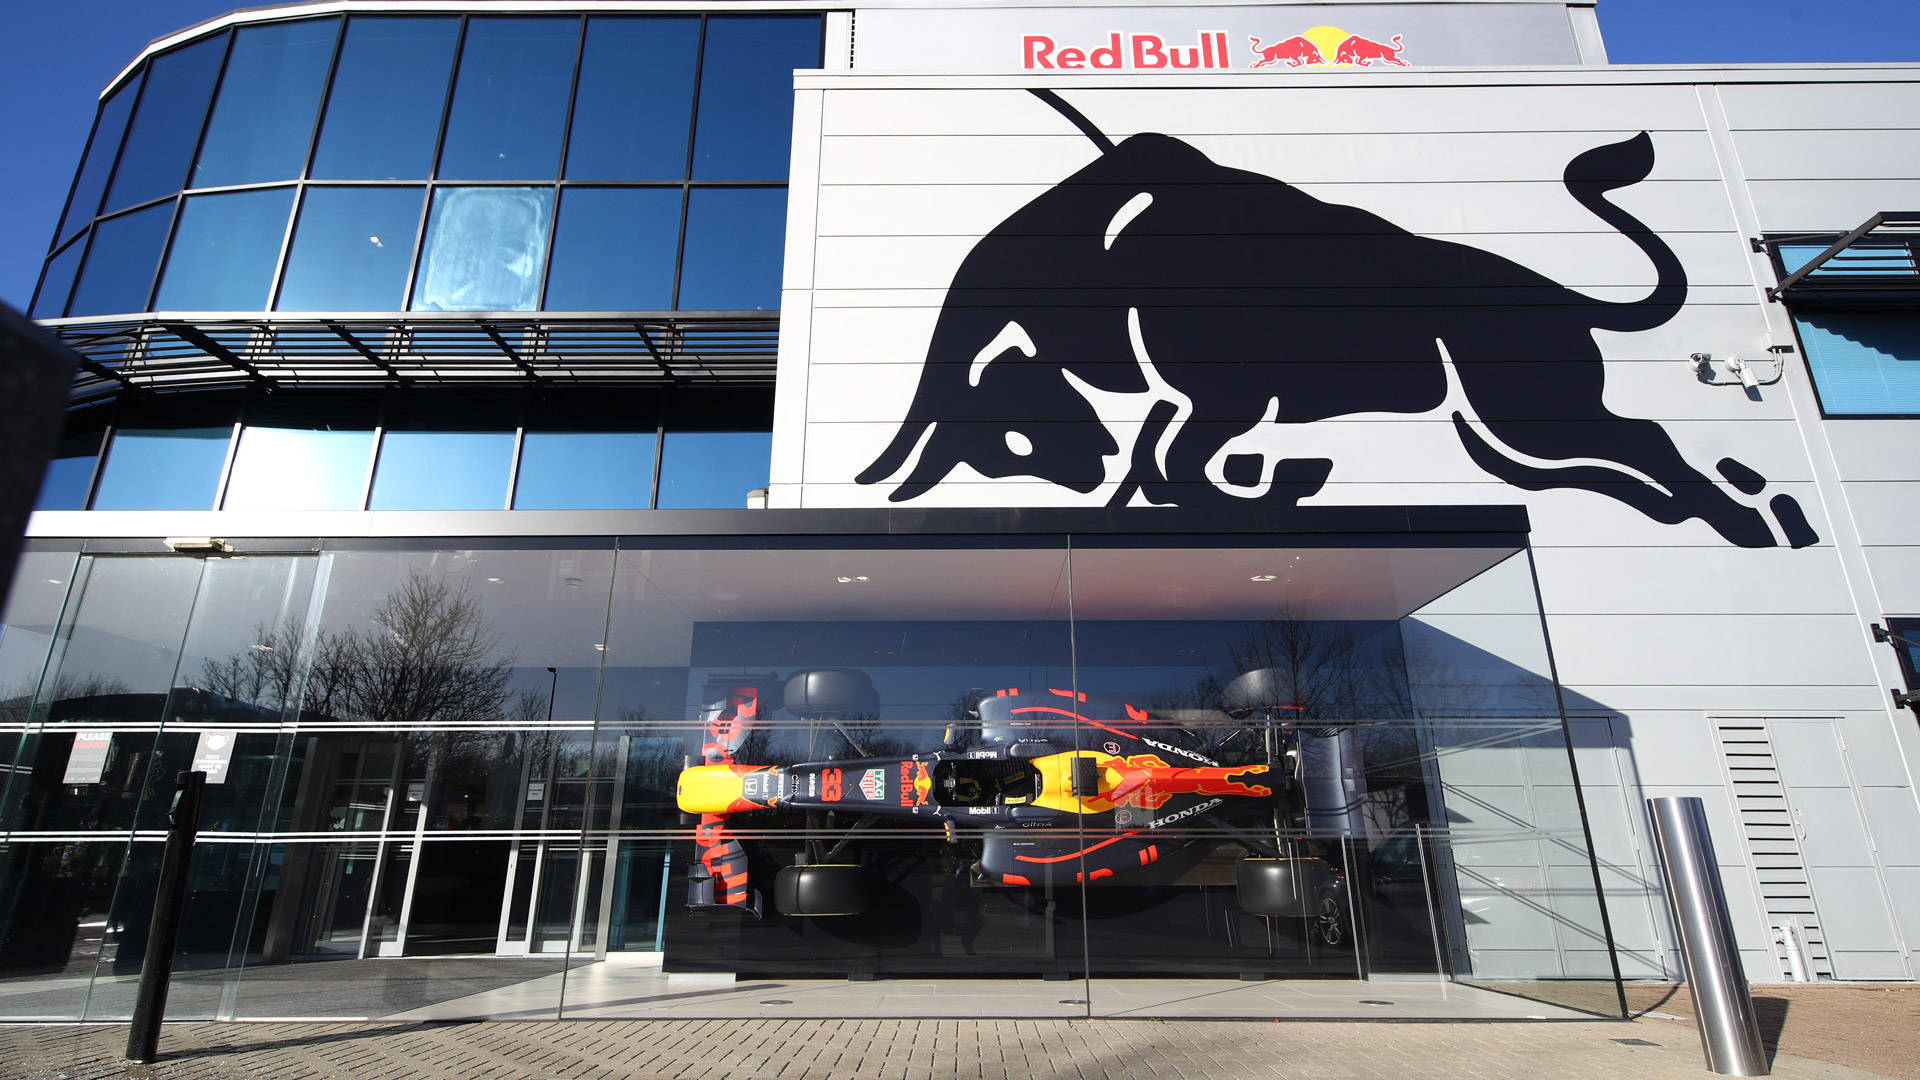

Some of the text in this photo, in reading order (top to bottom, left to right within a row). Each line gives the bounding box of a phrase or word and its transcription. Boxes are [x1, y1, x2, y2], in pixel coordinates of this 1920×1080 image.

[1023, 32, 1229, 69] Red Bull
[76, 732, 112, 741] PLEASE
[975, 751, 997, 759] Mobil
[1142, 738, 1219, 767] HONDA
[821, 768, 842, 802] 33
[863, 770, 874, 799] HEUER
[875, 771, 883, 798] TAG
[900, 761, 914, 806] Red Bull
[969, 807, 991, 815] Mobil
[1148, 798, 1223, 829] HONDA
